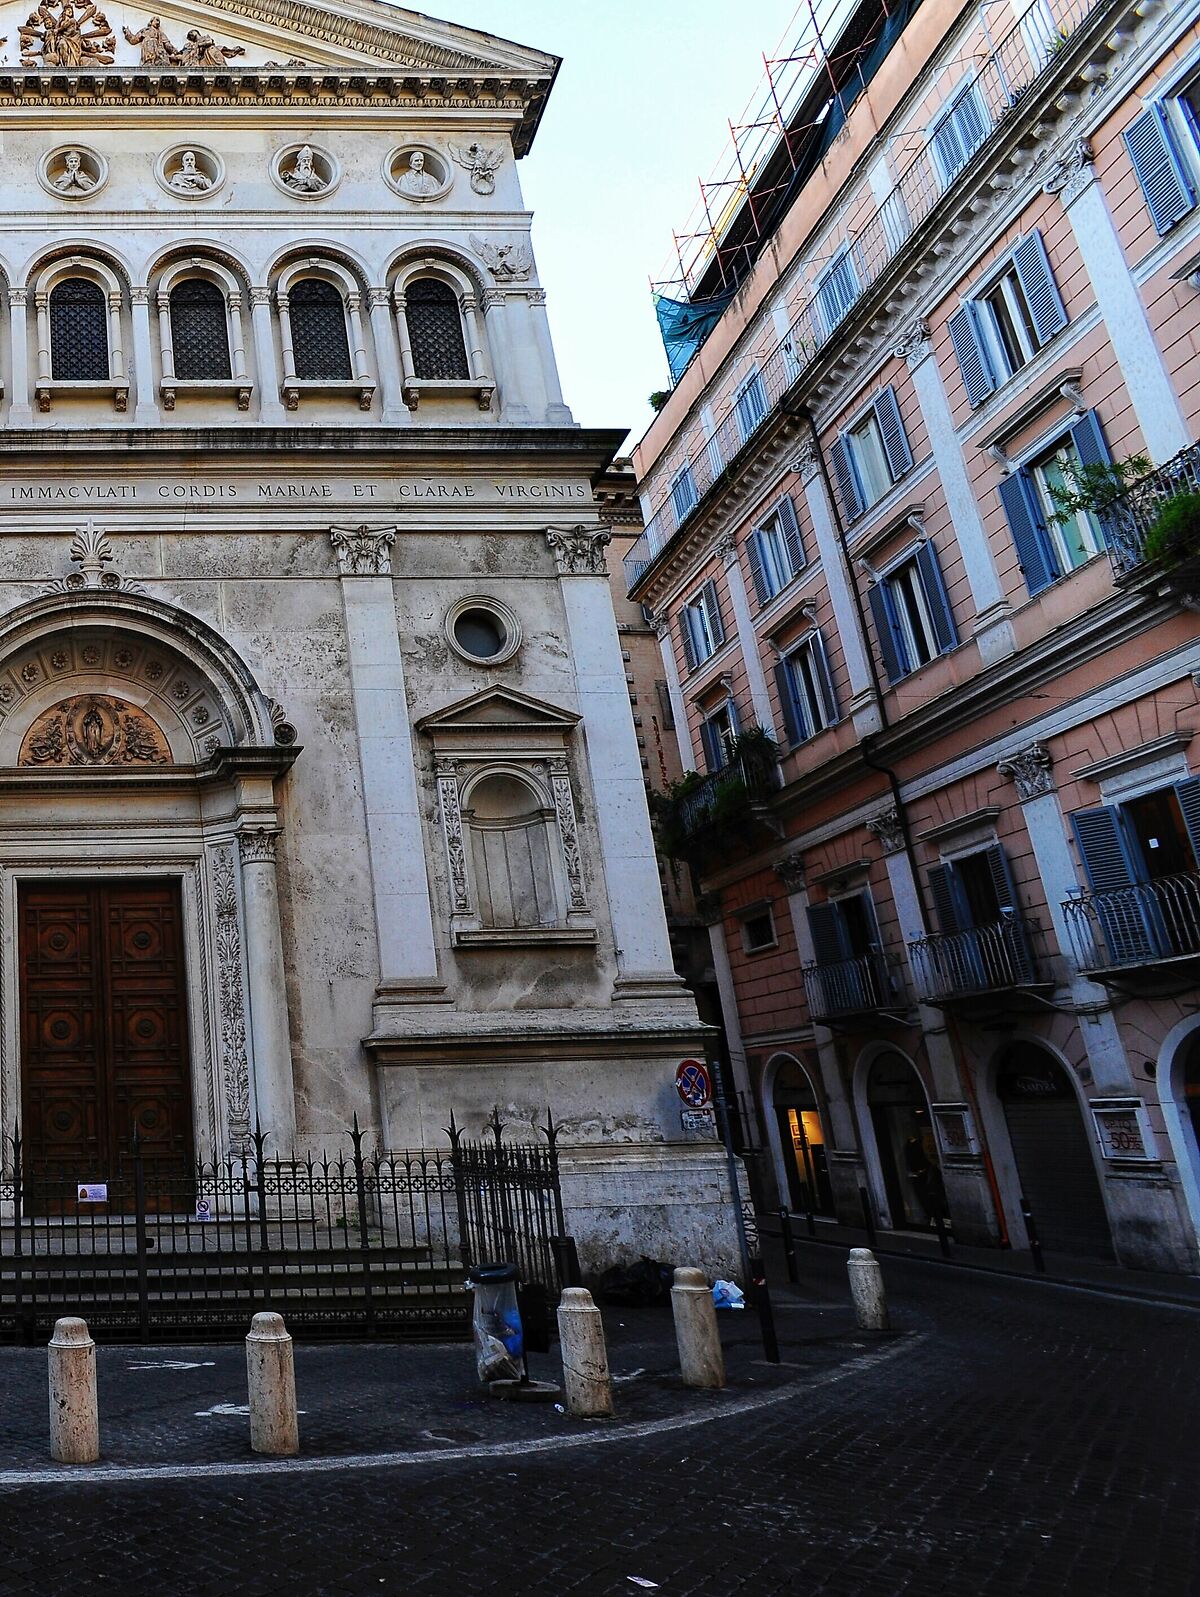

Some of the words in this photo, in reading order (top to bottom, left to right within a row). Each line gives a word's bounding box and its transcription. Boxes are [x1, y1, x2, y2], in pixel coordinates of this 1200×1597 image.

[11, 485, 137, 498] IMMACVLATI
[158, 485, 237, 497] CORDIS
[257, 484, 332, 496] MARIAE
[353, 484, 377, 496] ET
[399, 485, 475, 496] CLARAE
[495, 485, 585, 497] VIRGINIS
